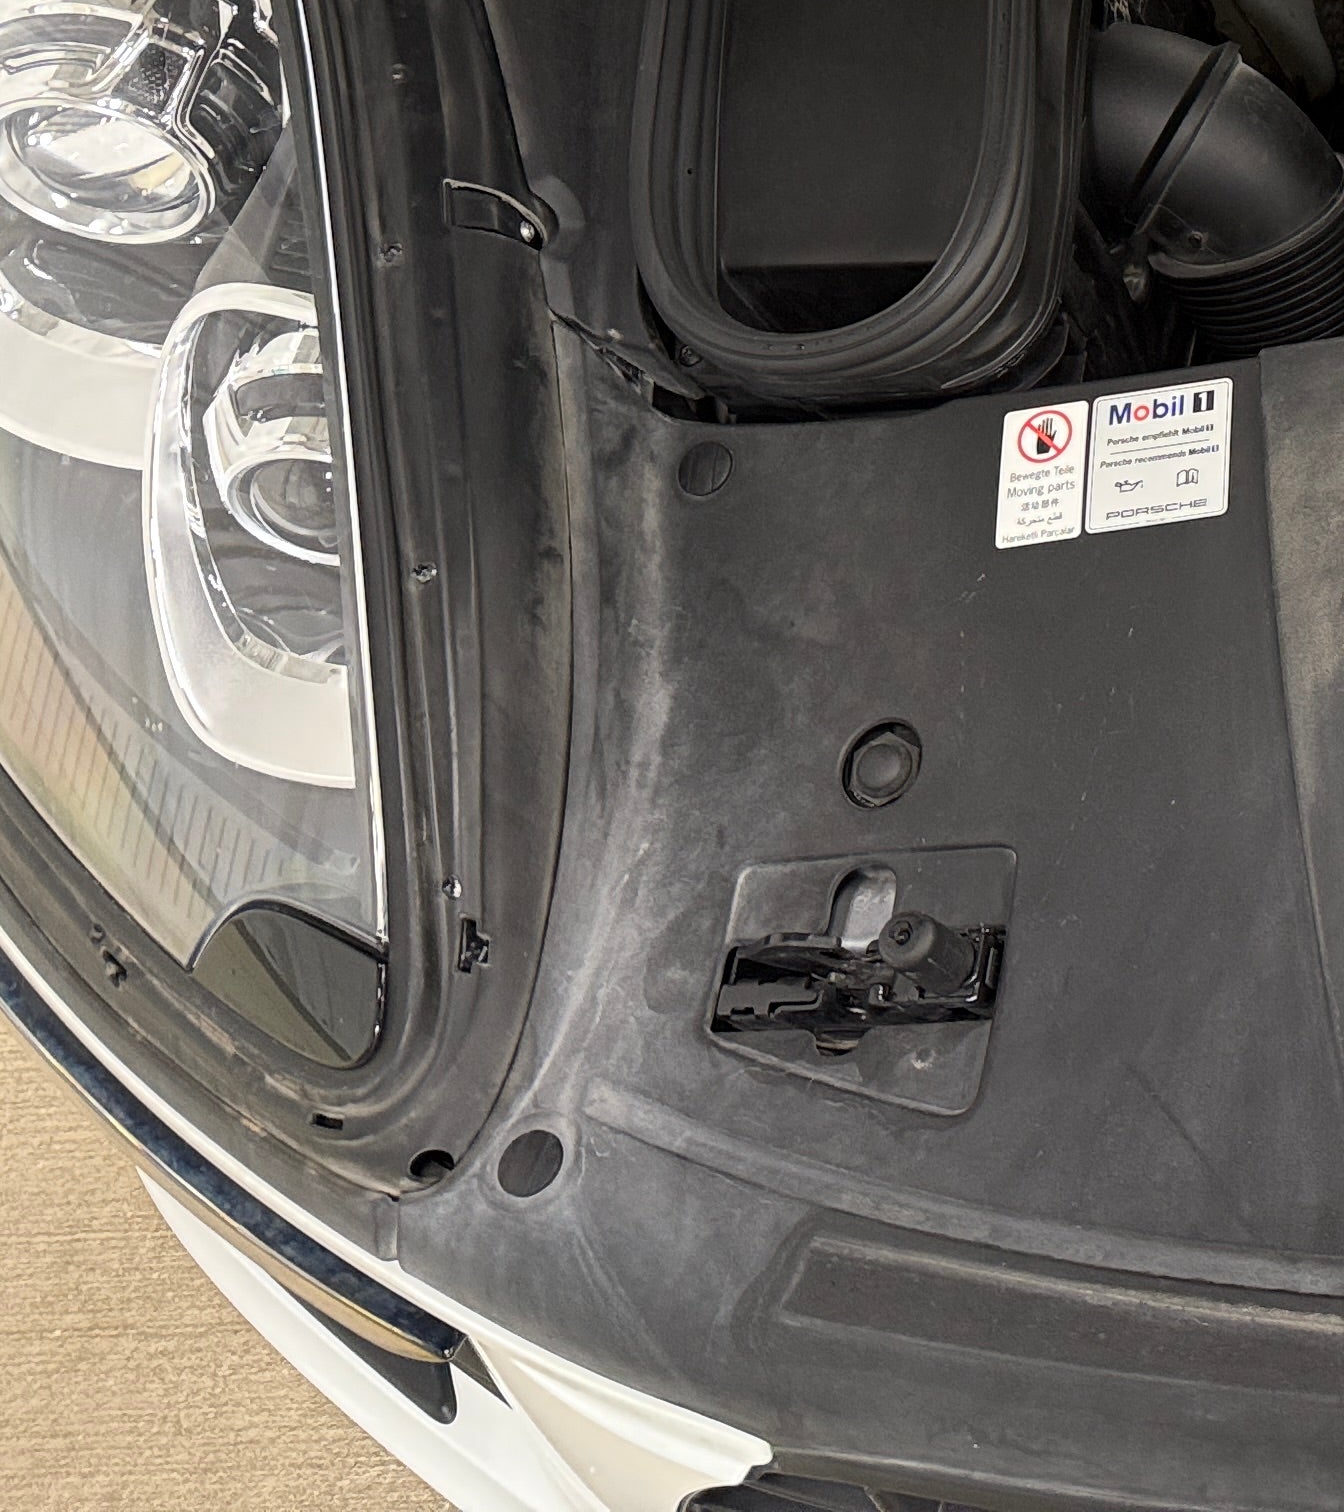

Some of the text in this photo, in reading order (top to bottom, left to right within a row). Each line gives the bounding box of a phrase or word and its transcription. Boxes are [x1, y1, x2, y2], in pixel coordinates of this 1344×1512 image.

[1108, 395, 1185, 426] Mobil
[1107, 436, 1139, 447] Porsche
[1182, 425, 1205, 436] Mobil
[1100, 459, 1132, 469] Porsche
[1135, 450, 1187, 464] recommends
[1188, 446, 1211, 456] Mobil
[1010, 469, 1050, 483] Bewegte
[1007, 480, 1075, 499] Moving parts
[1106, 498, 1207, 520] PORSCHE
